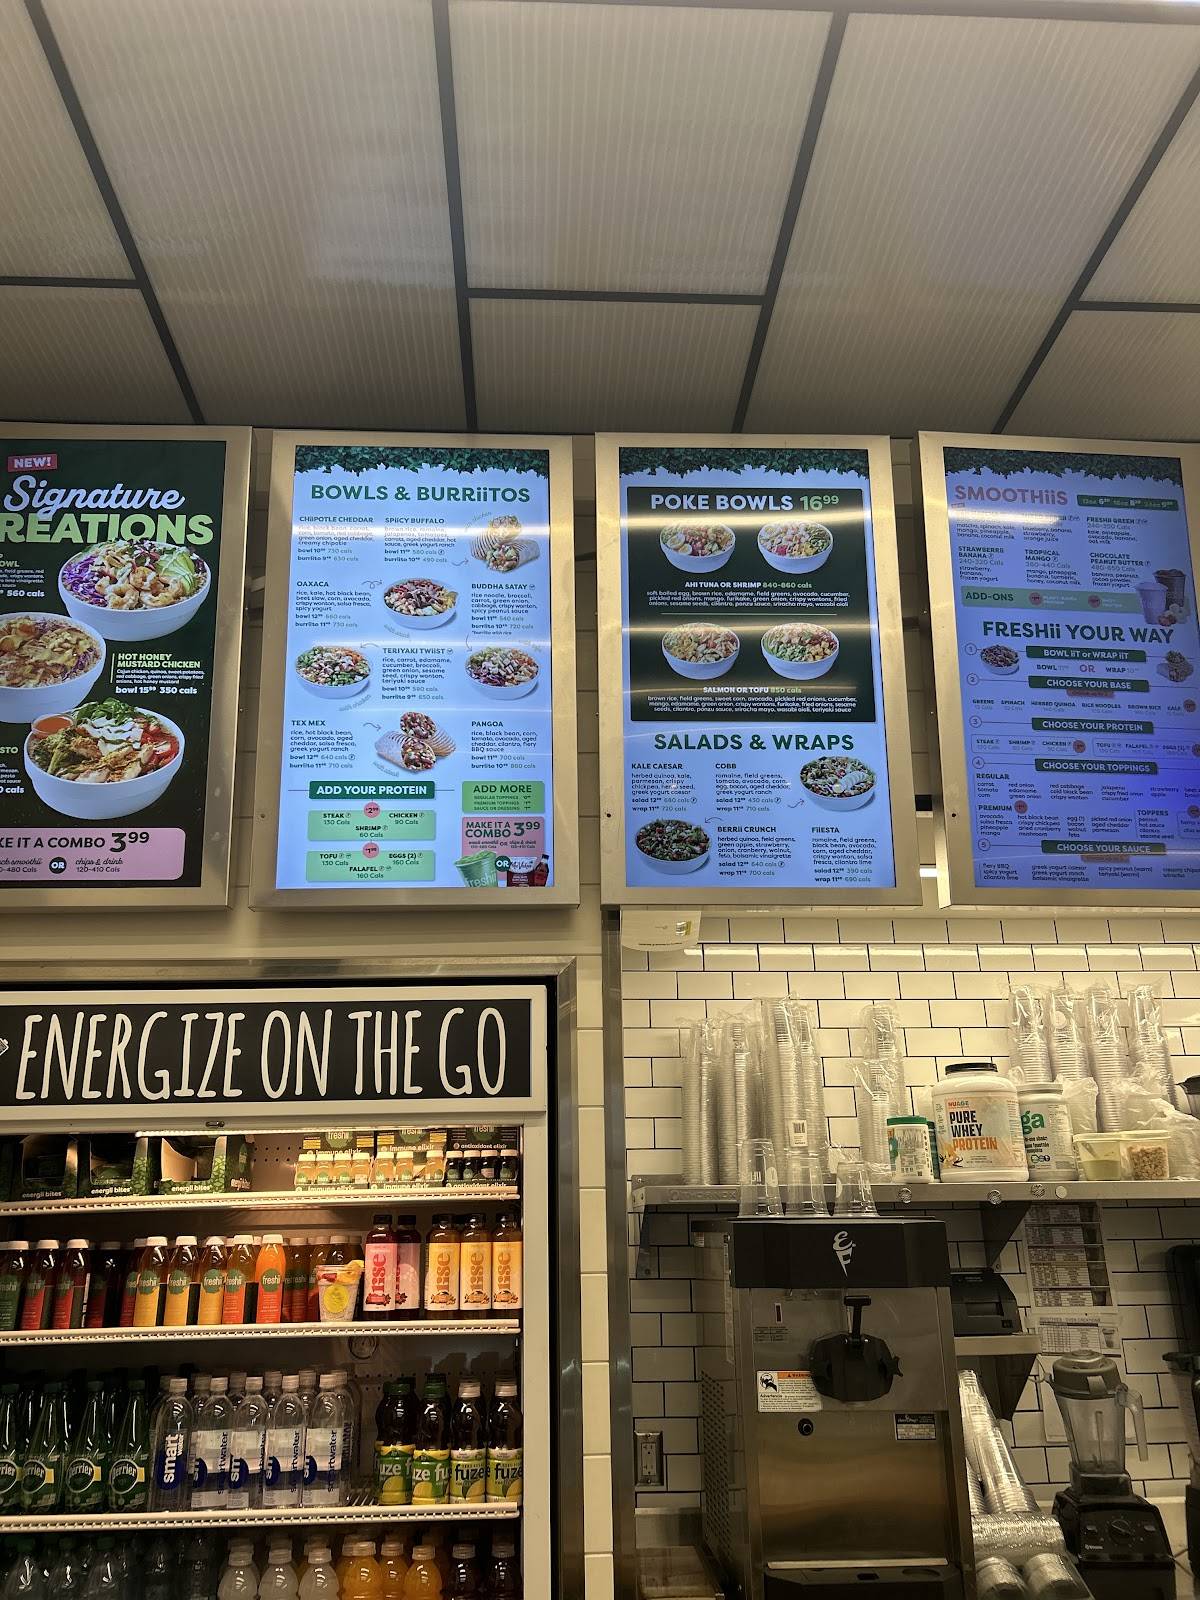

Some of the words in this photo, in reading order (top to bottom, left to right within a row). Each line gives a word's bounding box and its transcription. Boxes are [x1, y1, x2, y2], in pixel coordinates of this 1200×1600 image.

[13, 456, 52, 469] NEW!
[3, 474, 187, 521] Signature
[311, 485, 388, 500] BOWLS
[394, 486, 410, 501] &
[651, 494, 710, 509] POKE
[716, 494, 793, 510] BOWLS
[0, 512, 215, 545] REATIONS
[965, 592, 1014, 602] ADD-ONS
[1065, 624, 1125, 641] YOUR
[1129, 626, 1174, 644] WAY
[1044, 649, 1070, 658] BOWL
[1079, 664, 1096, 674] OR
[1046, 679, 1083, 688] CHOOSE
[1084, 680, 1108, 688] YOUR
[1110, 681, 1132, 690] BASE
[1042, 720, 1078, 729] CHOOSE
[1080, 721, 1105, 730] YOUR
[1106, 722, 1143, 731] PROTEIN
[654, 734, 742, 750] SALADS
[750, 734, 766, 750] &
[772, 735, 854, 751] WRAPS
[1043, 762, 1080, 770] CHOOSE
[1081, 763, 1106, 771] YOUR
[1107, 763, 1150, 772] TOPPINGS
[316, 786, 342, 794] ADD
[344, 785, 376, 794] YOUR
[379, 785, 426, 794] PROTEIN
[500, 785, 532, 793] MORE
[465, 829, 512, 838] COMBO
[0, 838, 13, 848] KE
[17, 837, 31, 848] IT
[34, 838, 44, 848] A
[48, 837, 105, 848] COMBO
[1057, 844, 1094, 852] CHOOSE
[1121, 845, 1151, 853] SAUCE
[16, 1012, 245, 1100] ENERGIZE
[261, 1010, 333, 1098] ON
[348, 1010, 423, 1096] THE
[438, 1008, 506, 1095] GO
[949, 1110, 976, 1124] PURE
[1021, 1110, 1045, 1134] ga
[951, 1124, 982, 1138] WHEY
[953, 1136, 998, 1150] PROTEIN
[164, 1434, 178, 1484] smart
